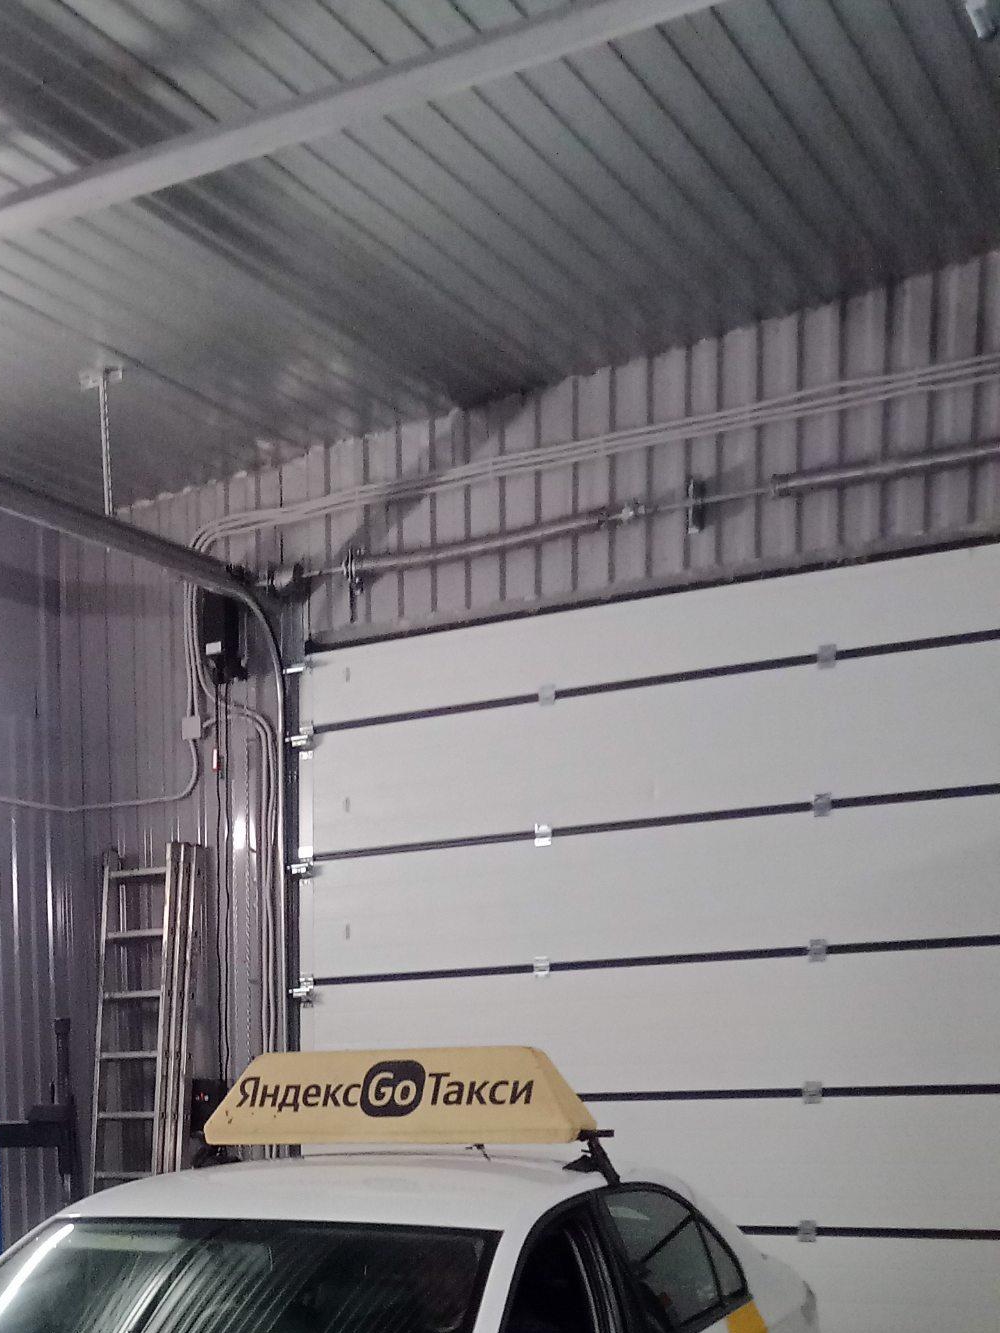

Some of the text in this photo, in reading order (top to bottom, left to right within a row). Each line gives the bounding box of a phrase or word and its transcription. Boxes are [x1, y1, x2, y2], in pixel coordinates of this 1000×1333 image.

[236, 1072, 535, 1111] Яндекс Go Такси
